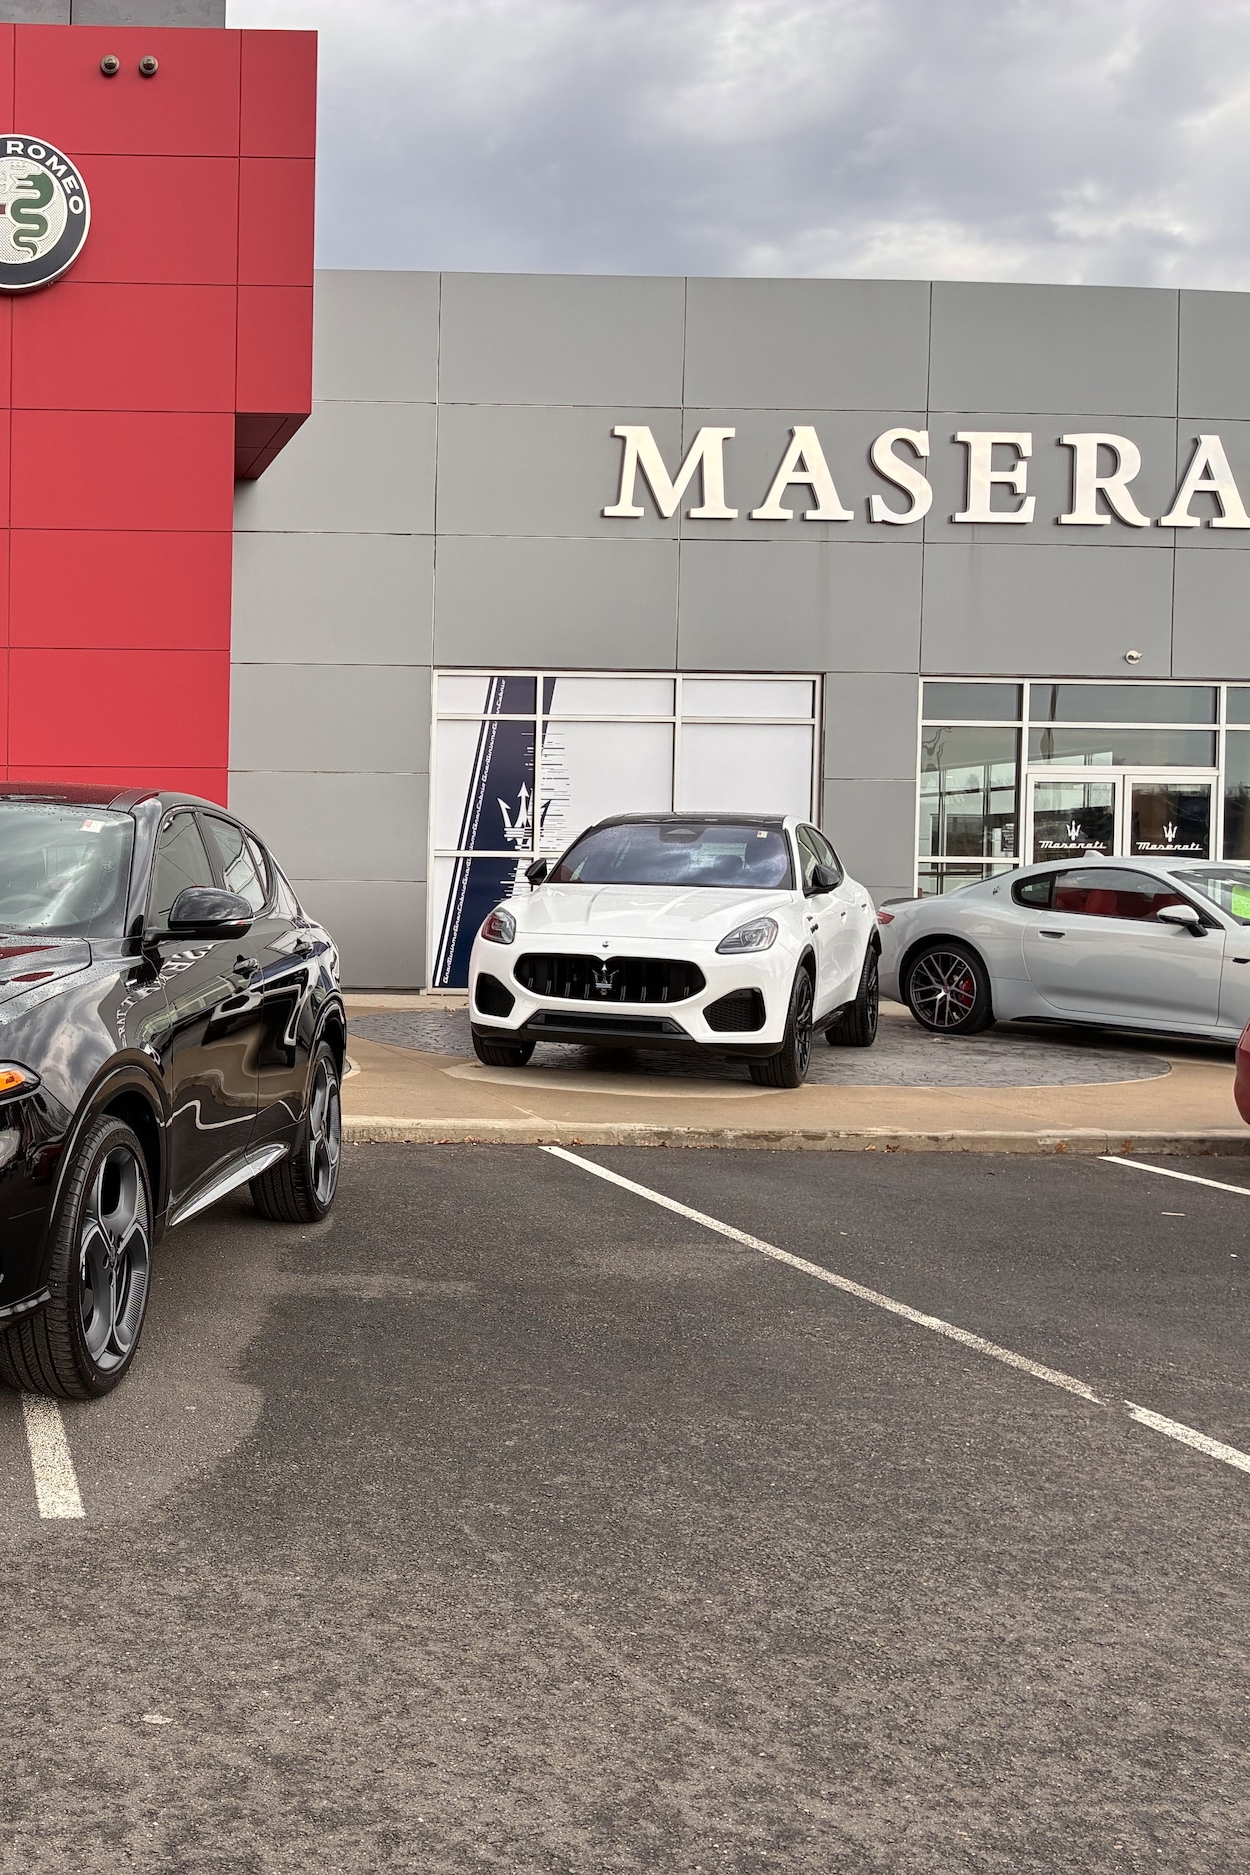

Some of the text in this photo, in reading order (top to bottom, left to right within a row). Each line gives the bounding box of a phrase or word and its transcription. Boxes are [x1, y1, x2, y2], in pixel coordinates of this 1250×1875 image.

[6, 140, 84, 215] ROMEO
[602, 424, 1250, 530] MASERA
[1038, 841, 1107, 849] Maserati
[1136, 842, 1203, 850] Maserati
